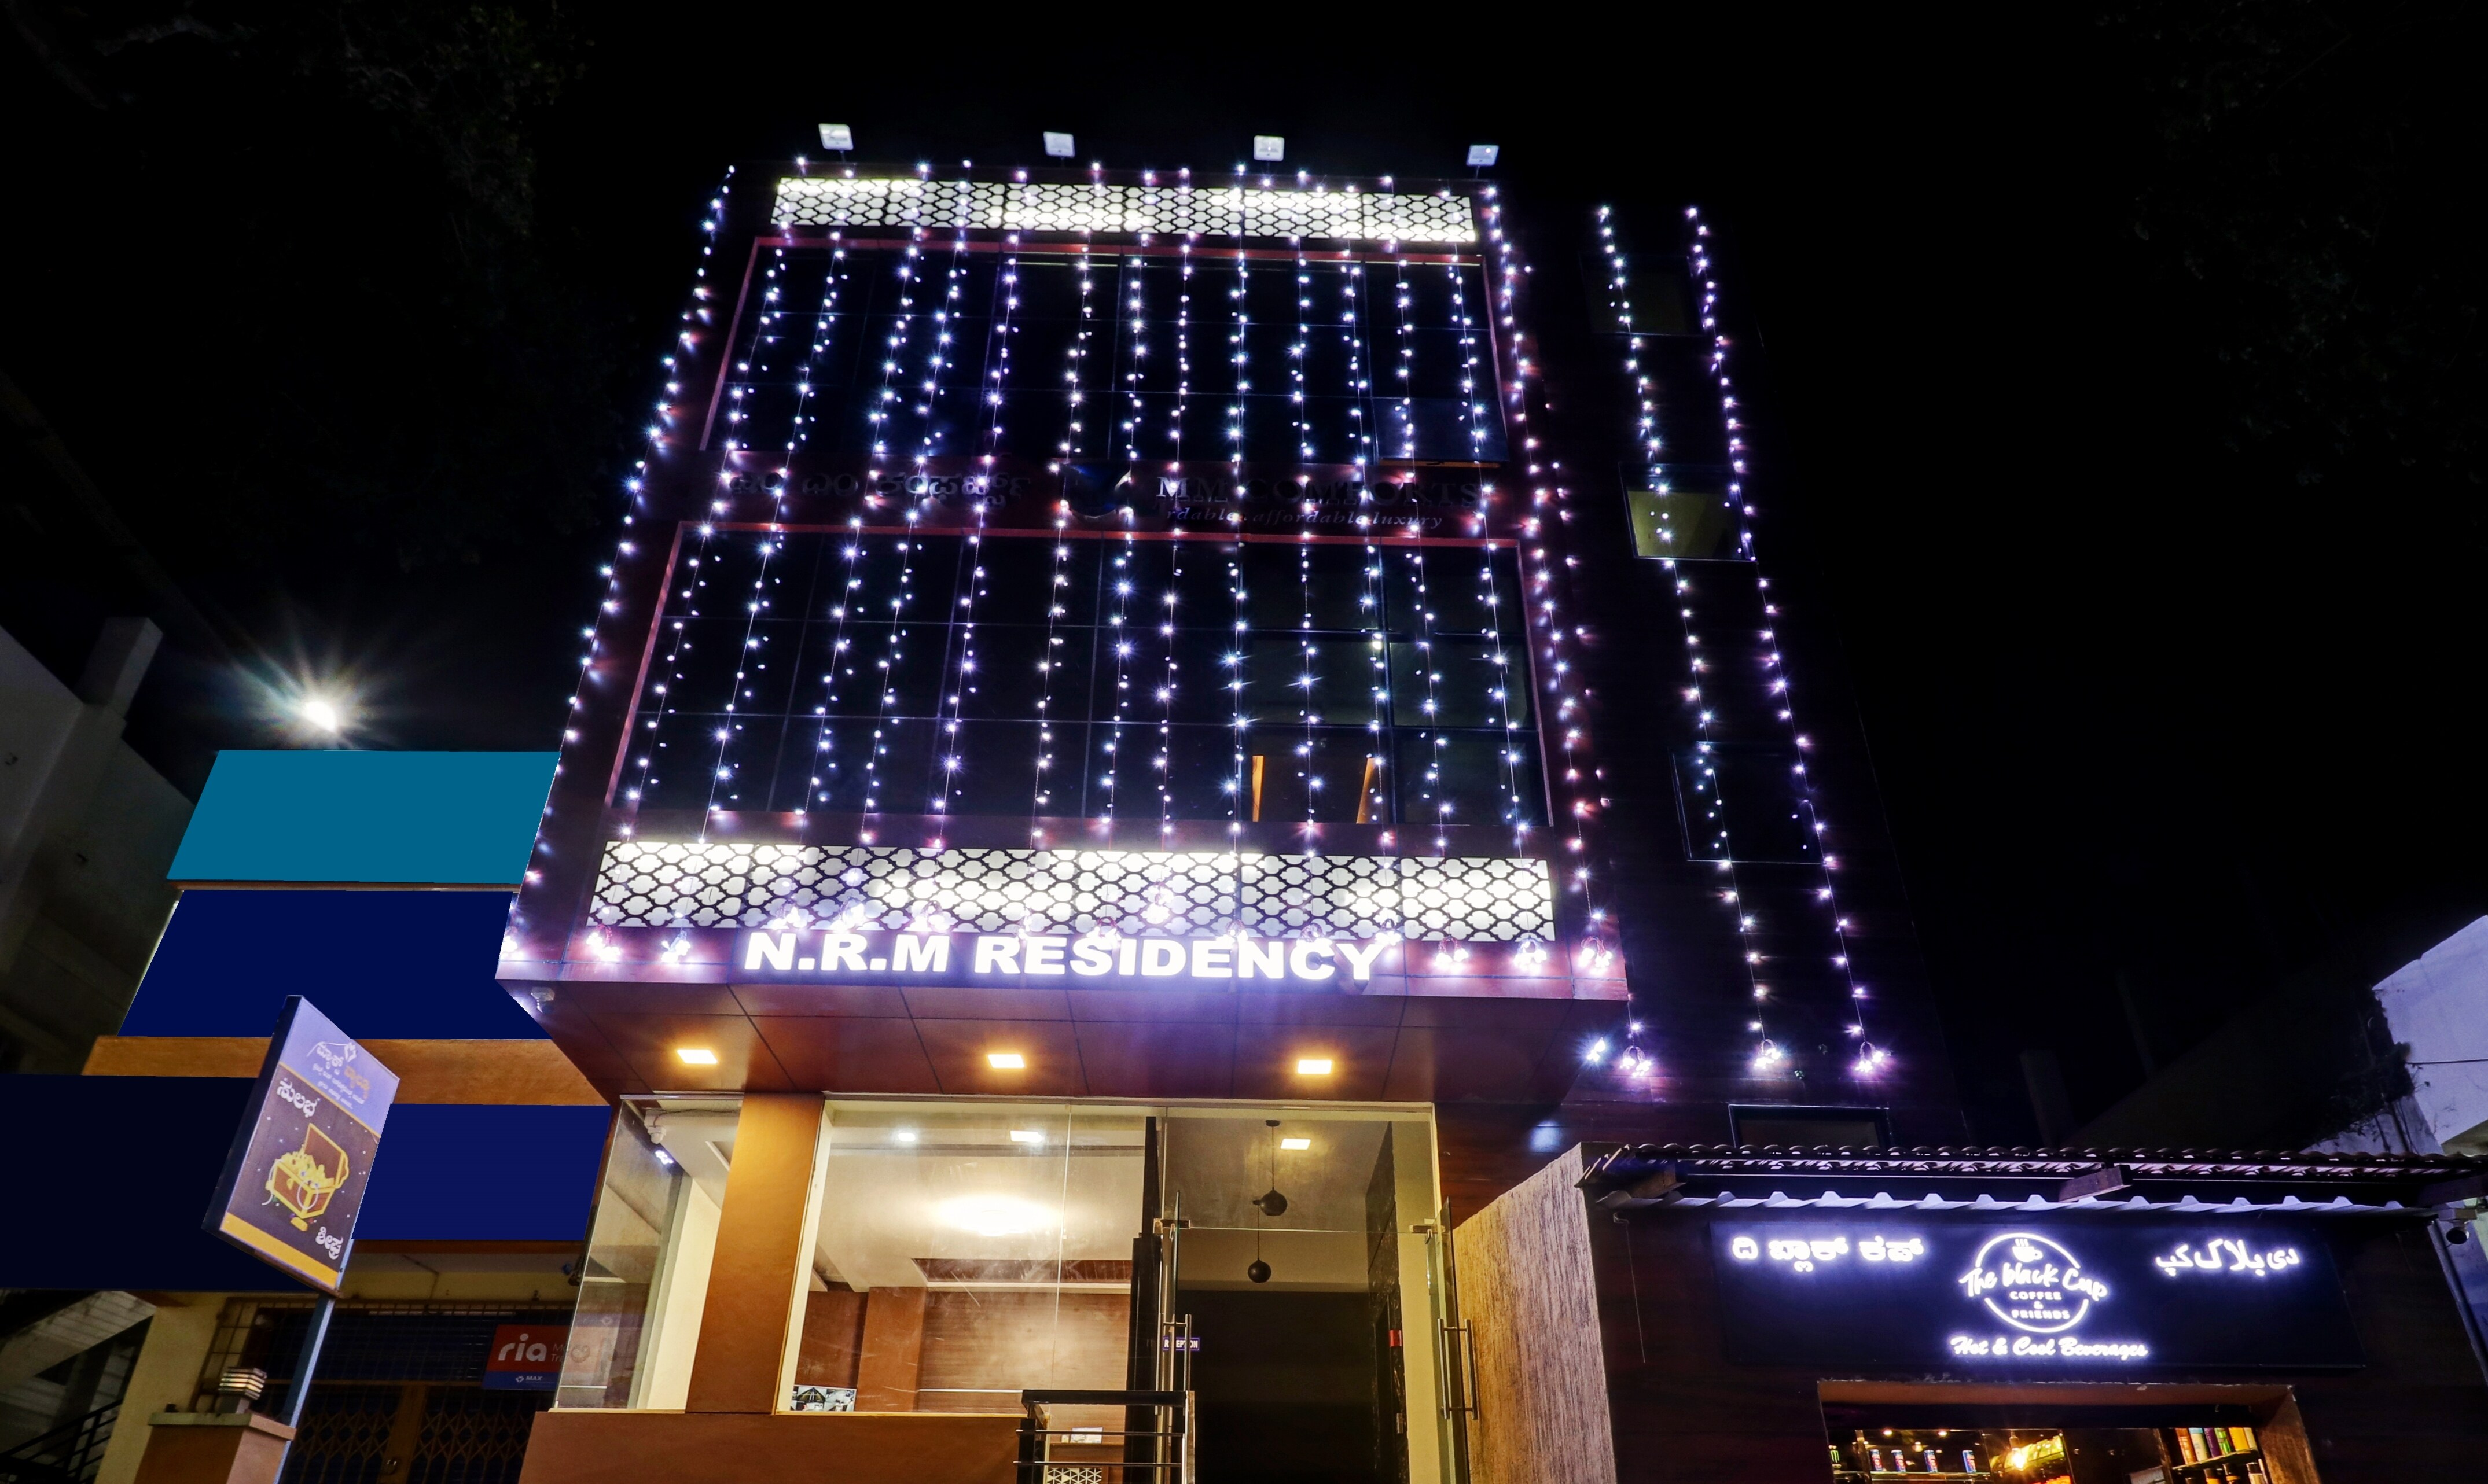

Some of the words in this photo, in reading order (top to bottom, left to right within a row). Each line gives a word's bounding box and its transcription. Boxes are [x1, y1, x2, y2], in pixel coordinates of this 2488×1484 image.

[1242, 478, 1477, 506] COMFORTS
[1372, 511, 1442, 529] luxury
[744, 932, 950, 973] N.R.M
[974, 936, 1384, 981] RESIDENCY
[277, 1079, 317, 1118] ಸುಲಭ
[1958, 1267, 1998, 1297] The
[2002, 1262, 2060, 1287] black
[2062, 1268, 2108, 1301] Cup
[2009, 1291, 2063, 1301] COFFEE
[2034, 1301, 2044, 1309] &
[2011, 1310, 2071, 1320] FRIENDS
[498, 1333, 547, 1362] ria
[1950, 1336, 1989, 1356] Hot
[1991, 1337, 2008, 1356] &
[2012, 1336, 2056, 1356] Cool
[2057, 1336, 2149, 1361] Beverages
